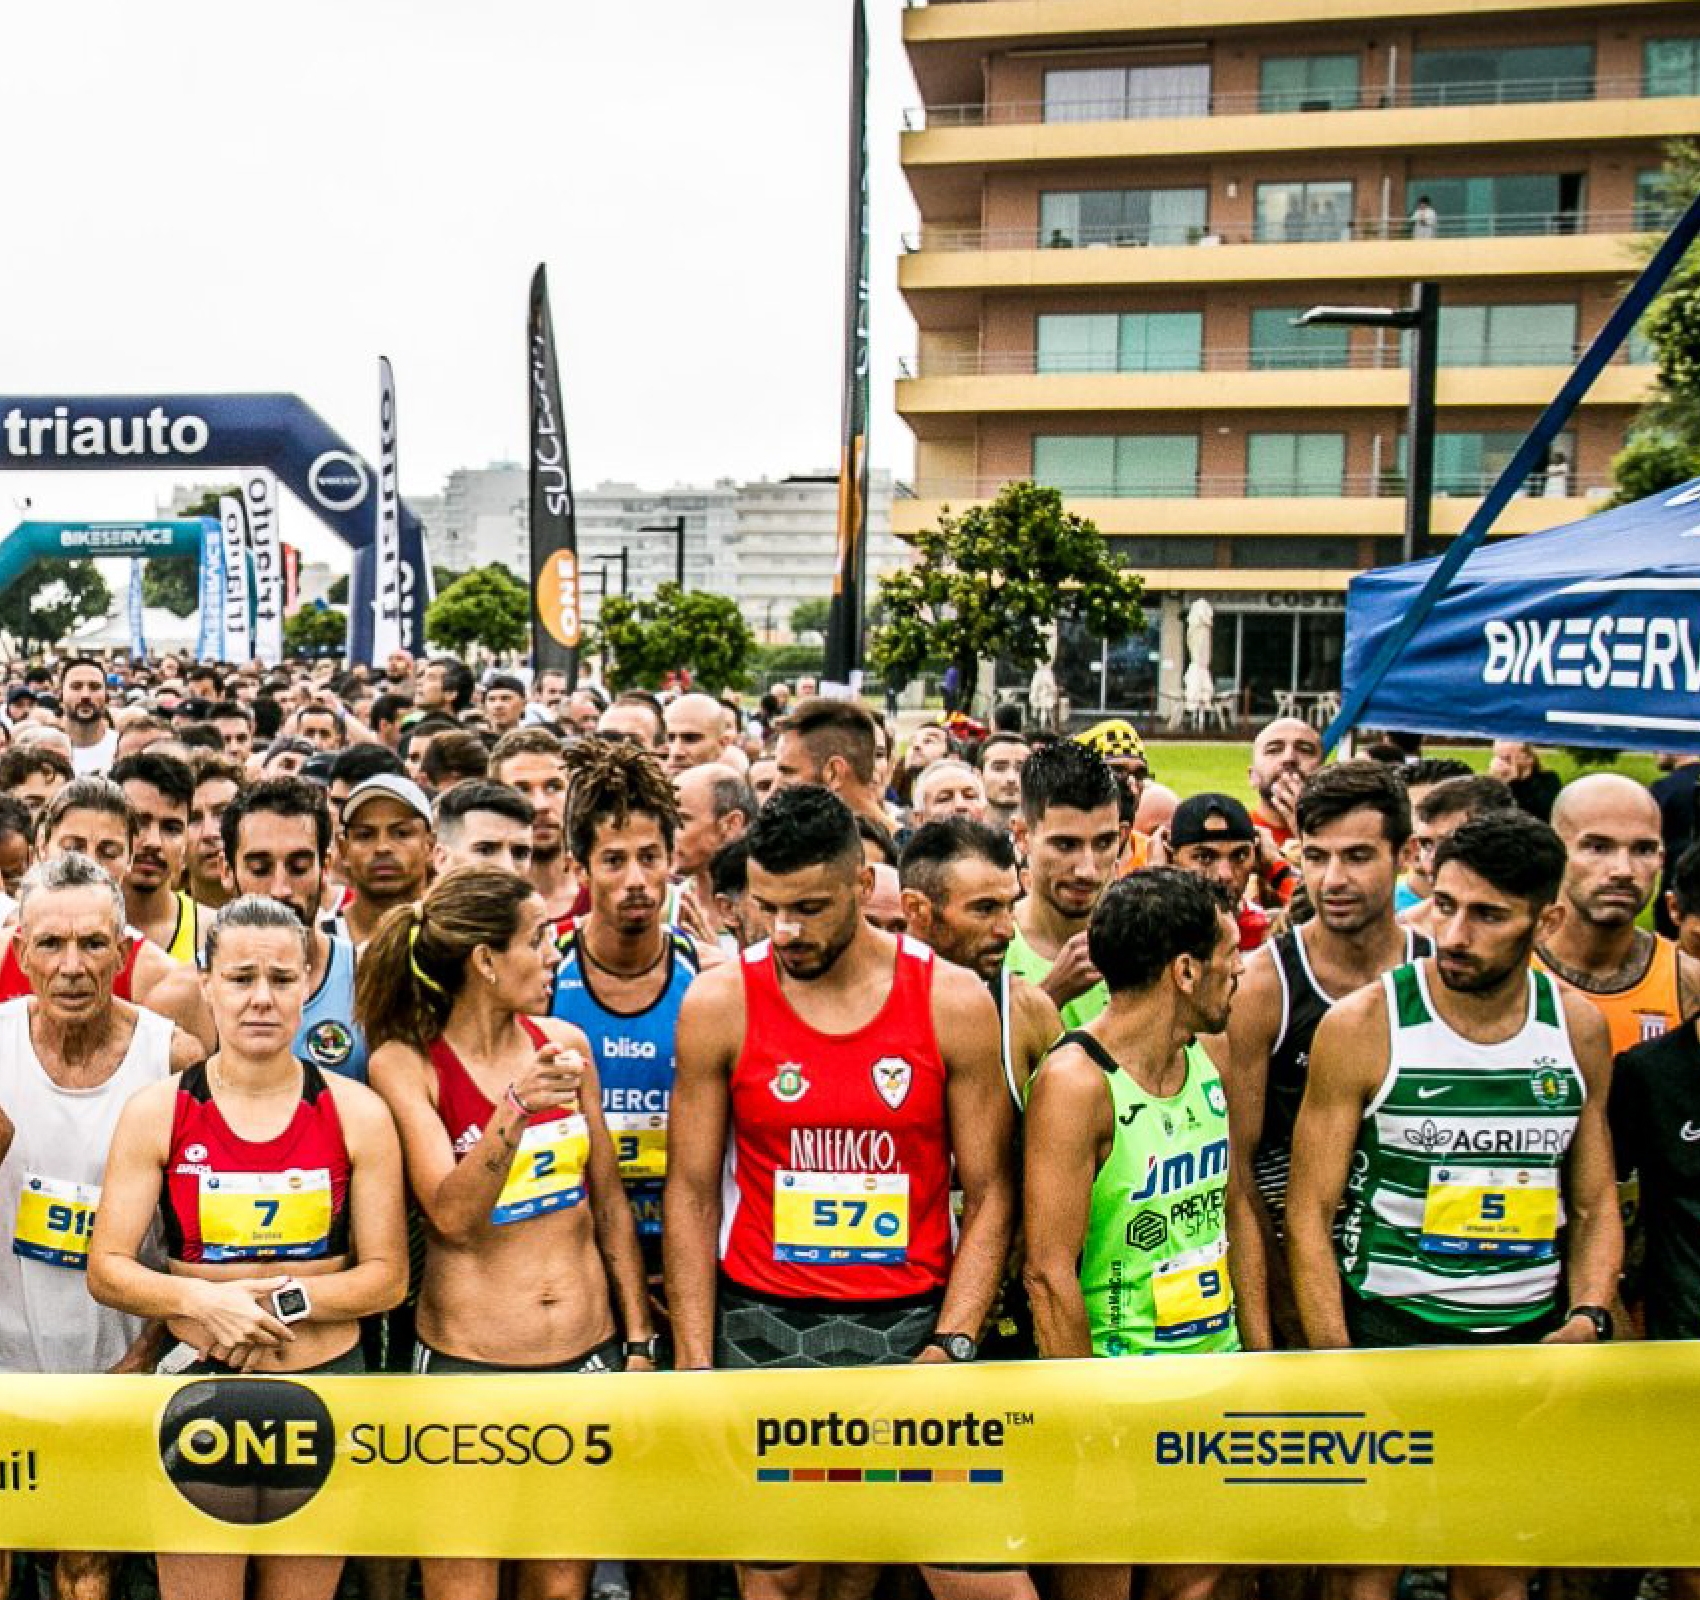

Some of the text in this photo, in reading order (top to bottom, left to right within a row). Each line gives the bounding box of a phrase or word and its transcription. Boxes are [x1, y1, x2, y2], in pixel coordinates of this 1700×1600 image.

[3, 406, 209, 455] triauto
[556, 557, 577, 638] ONE
[618, 1136, 639, 1161] 3
[532, 1150, 556, 1178] 2
[253, 1199, 280, 1227] 7
[814, 1199, 868, 1227] 57
[1480, 1193, 1506, 1220] 5
[1198, 1270, 1221, 1299] 9
[178, 1416, 613, 1466] ONE SUCESSO 5
[1156, 1430, 1434, 1466] BIKESERVICE
